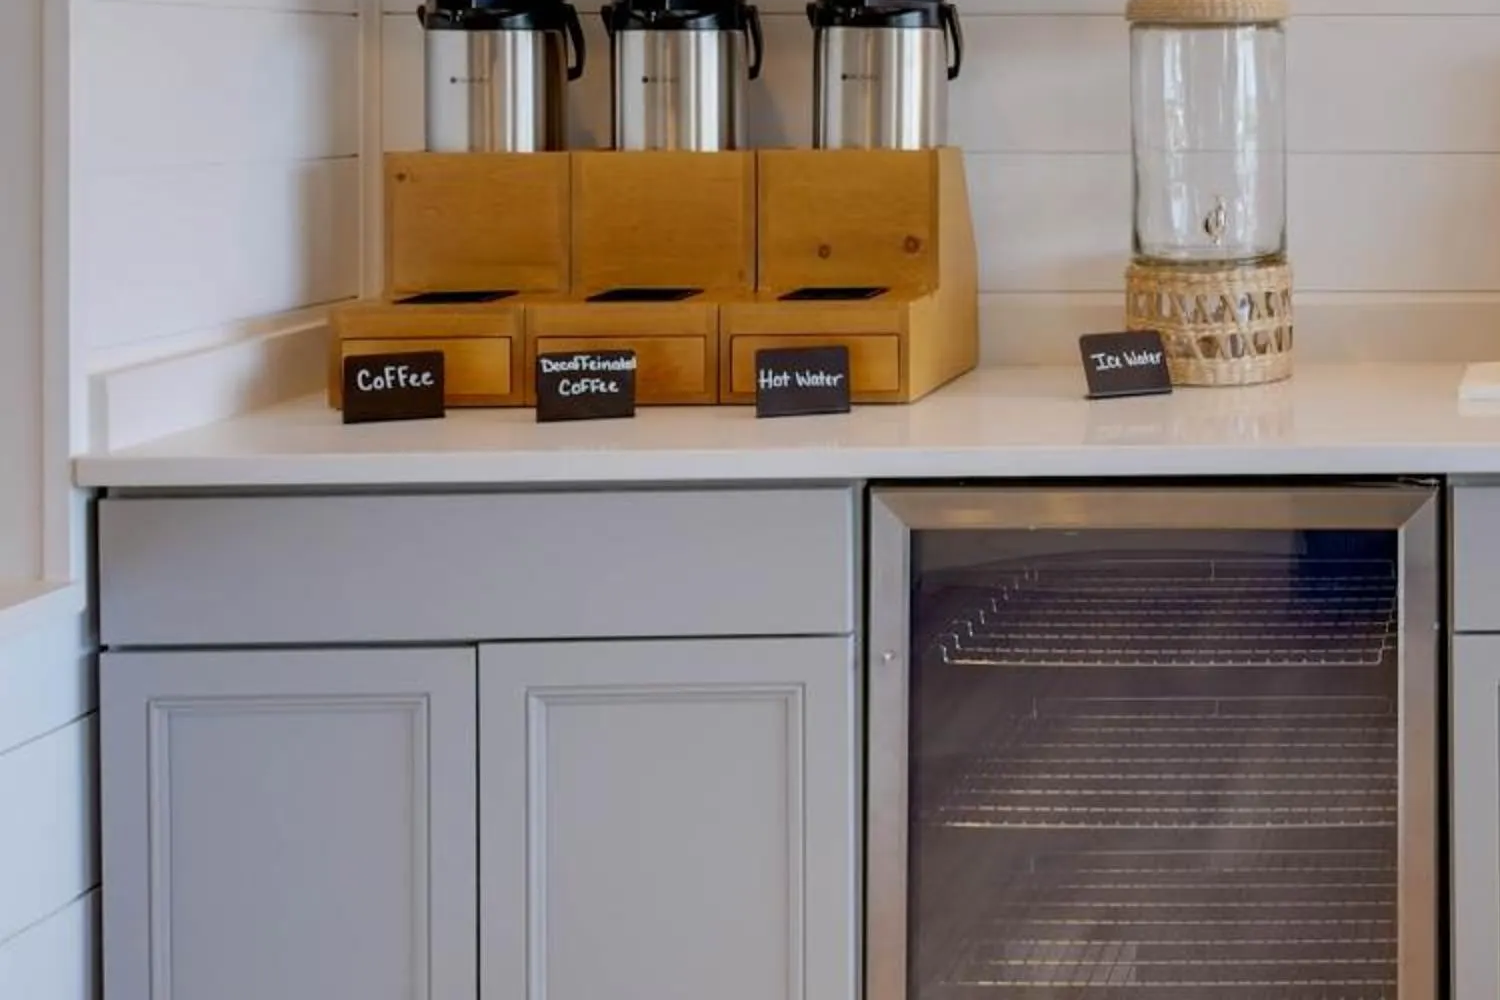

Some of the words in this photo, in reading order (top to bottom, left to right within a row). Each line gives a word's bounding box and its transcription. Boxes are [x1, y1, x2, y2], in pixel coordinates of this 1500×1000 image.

[1089, 352, 1122, 371] Ice
[1123, 350, 1163, 367] Water
[759, 368, 791, 389] Hot
[795, 369, 844, 387] Water
